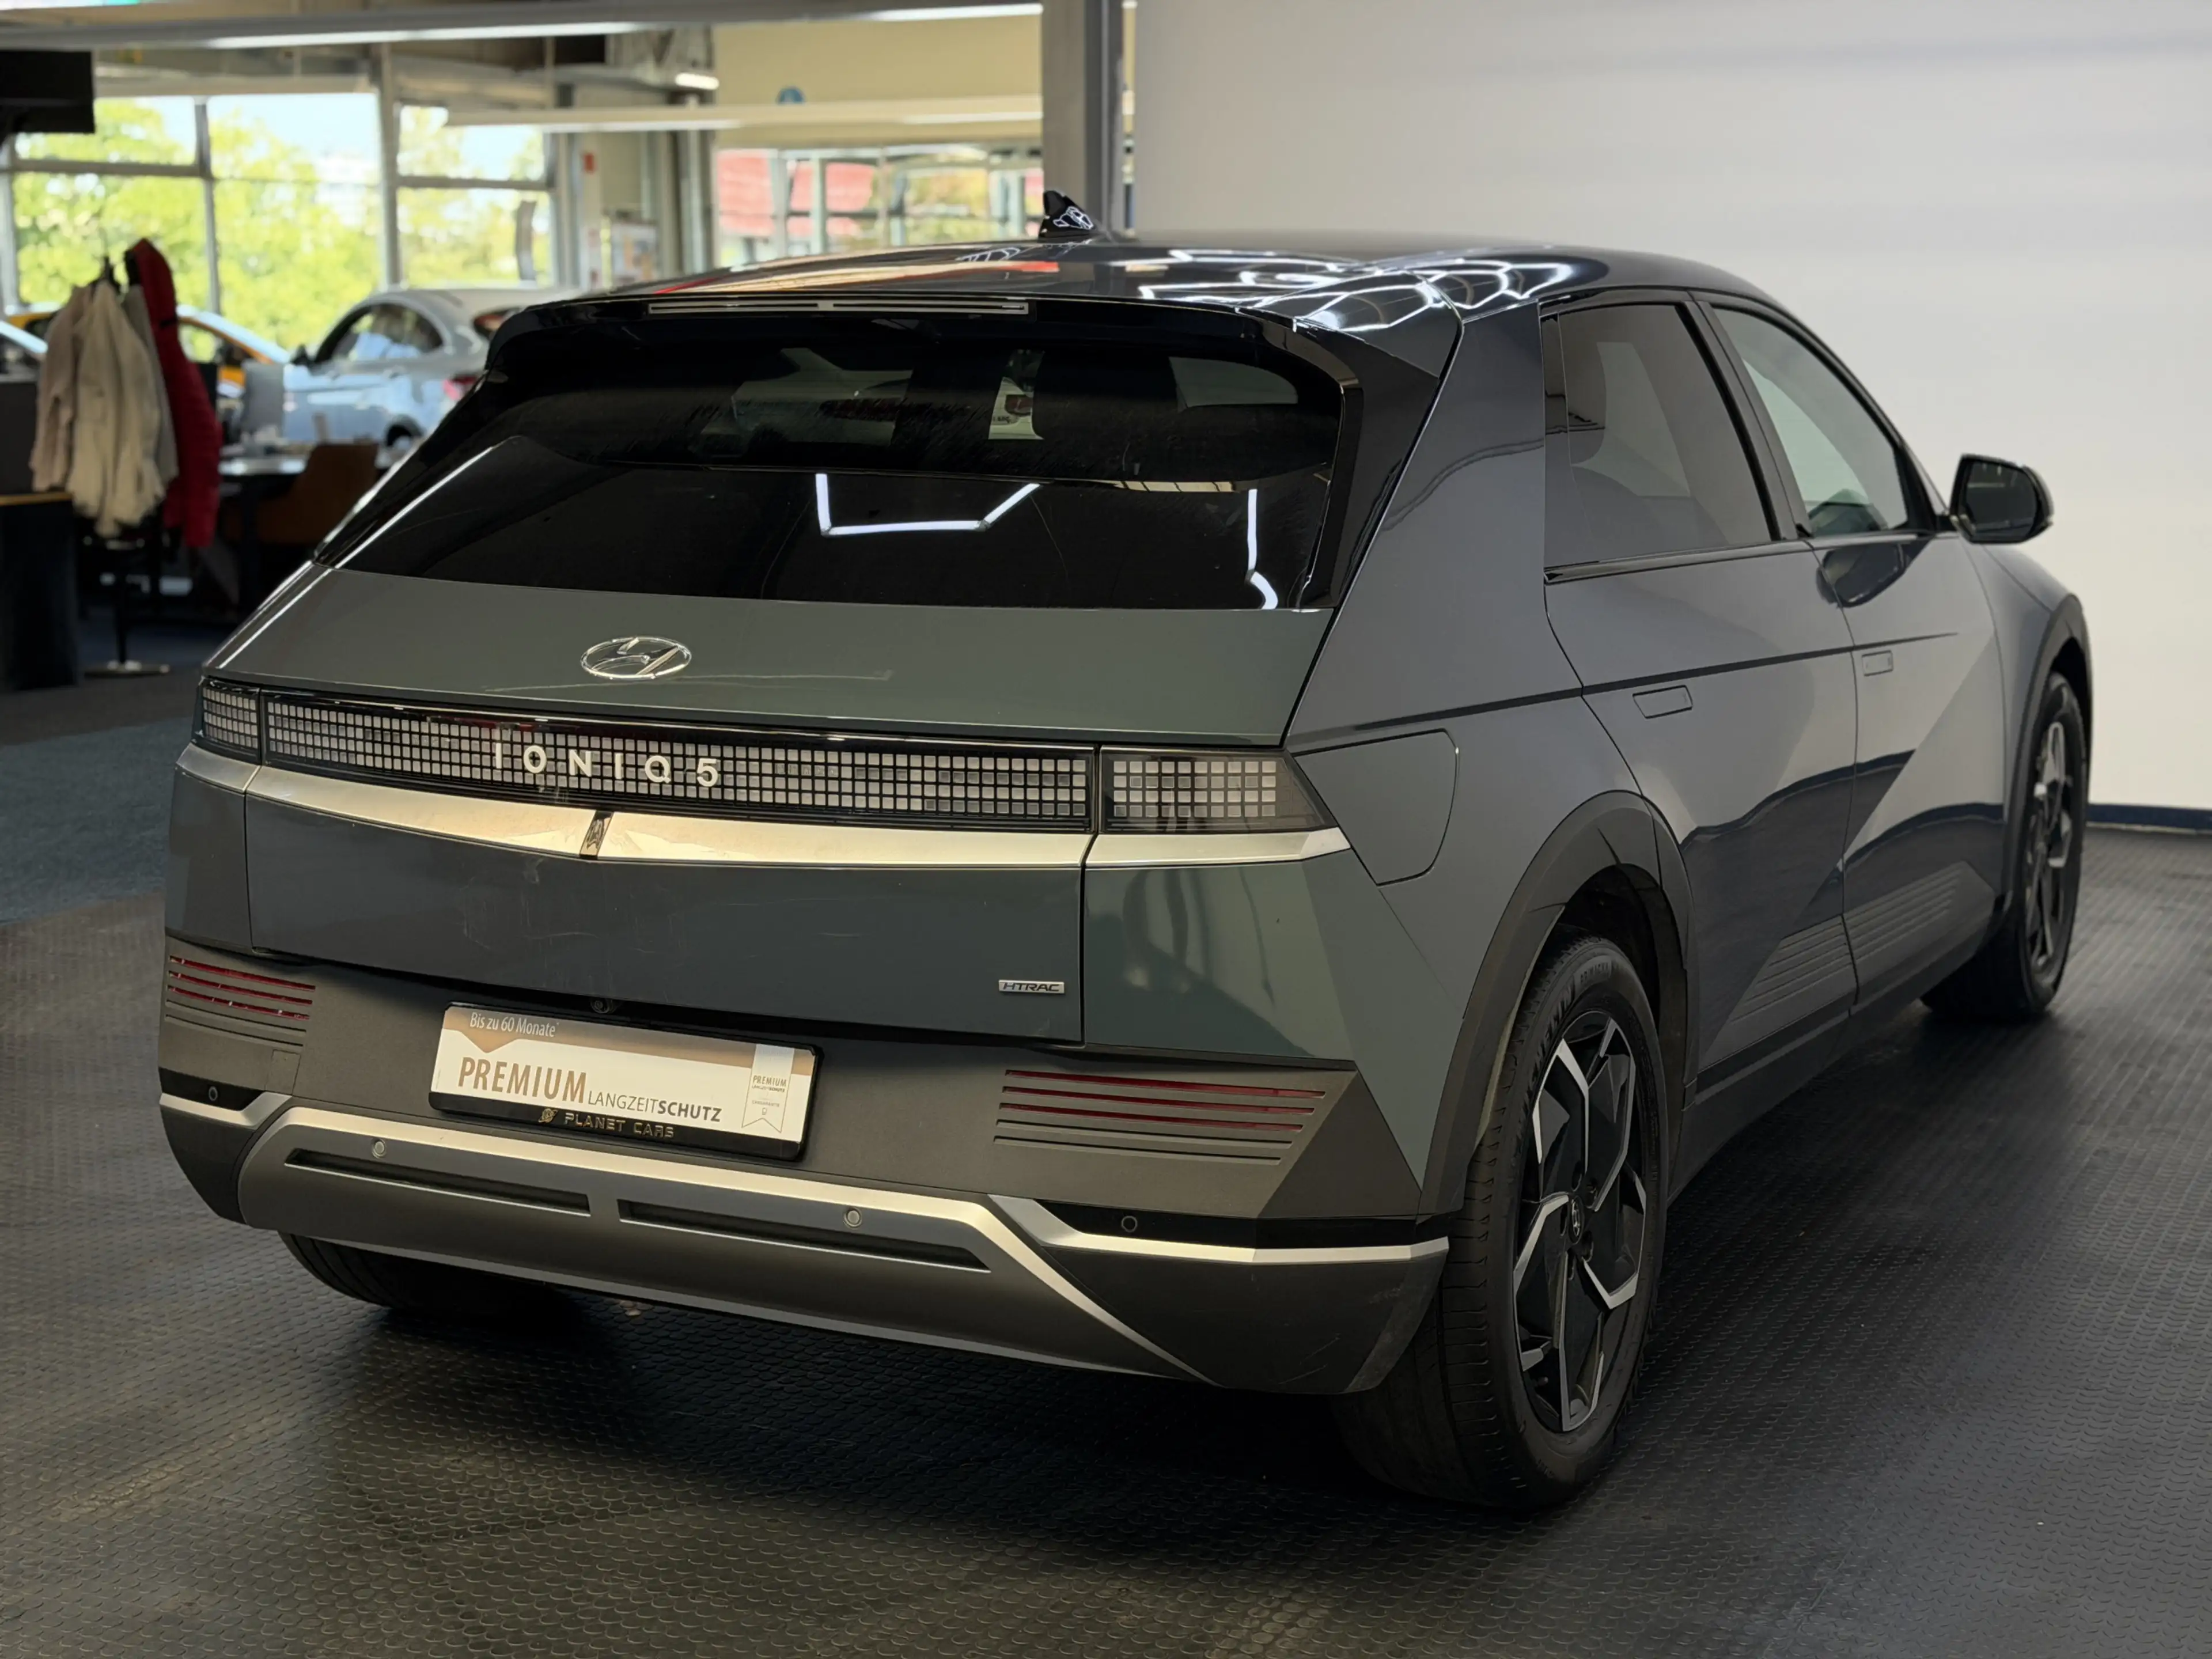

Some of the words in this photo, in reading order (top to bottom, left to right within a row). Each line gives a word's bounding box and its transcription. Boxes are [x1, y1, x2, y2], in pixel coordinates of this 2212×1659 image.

[1003, 982, 1060, 992] HTRAC
[470, 1012, 486, 1029] Bis
[486, 1018, 499, 1031] zu
[501, 1017, 515, 1032] 60
[458, 1056, 586, 1104] PREMIUM
[588, 1090, 722, 1122] LANGZEITSCHUTZ
[752, 1075, 787, 1087] PREMIUM
[565, 1112, 626, 1132] PLANET
[634, 1122, 675, 1138] CARS
